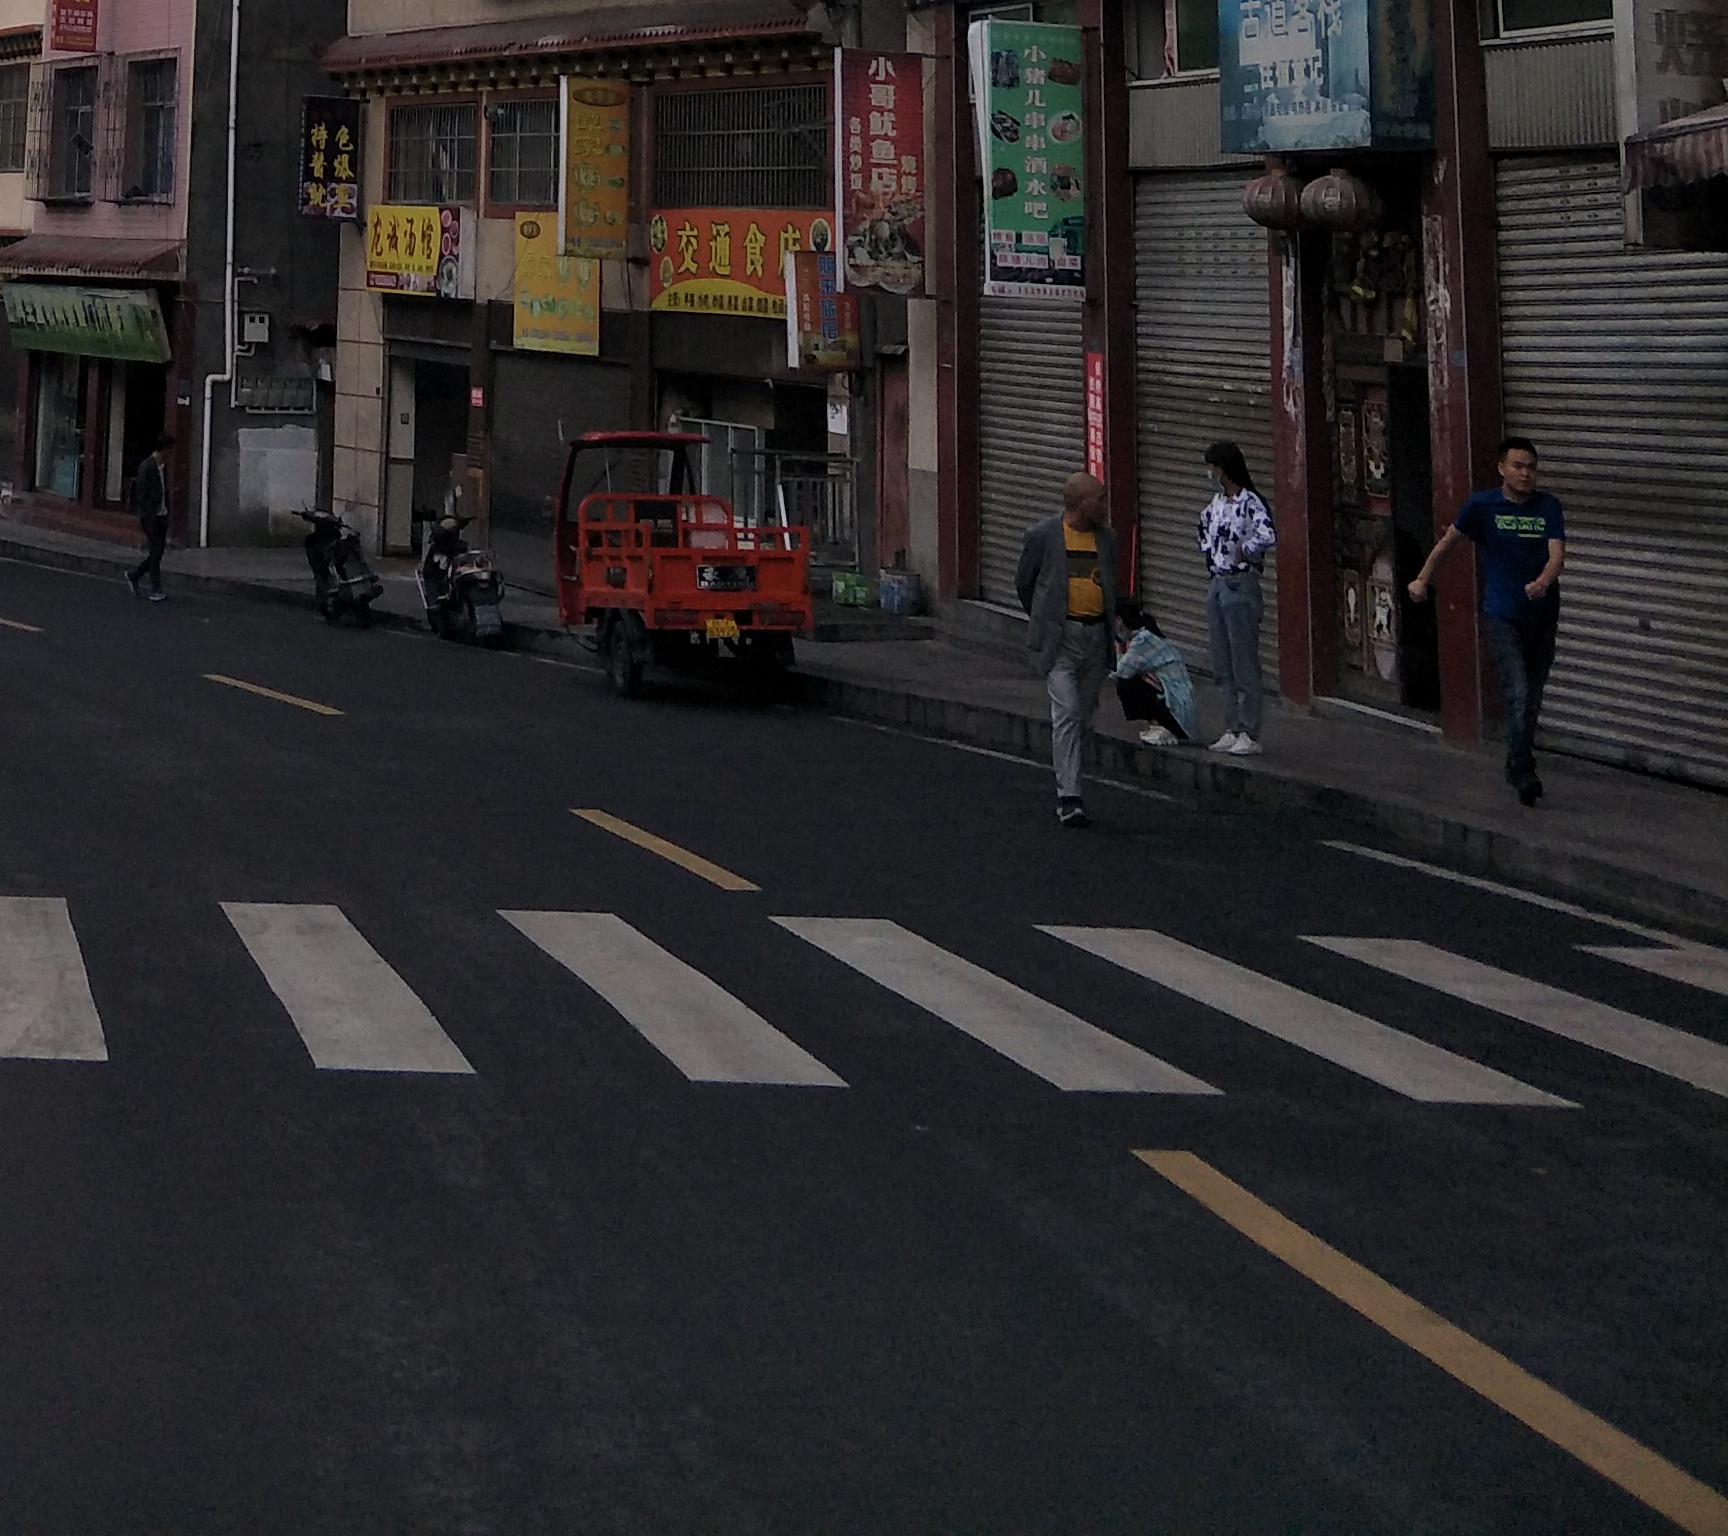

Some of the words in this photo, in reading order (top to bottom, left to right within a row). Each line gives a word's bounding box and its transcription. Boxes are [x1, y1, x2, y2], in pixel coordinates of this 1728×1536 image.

[867, 55, 899, 198] 小哥鱿鱼店
